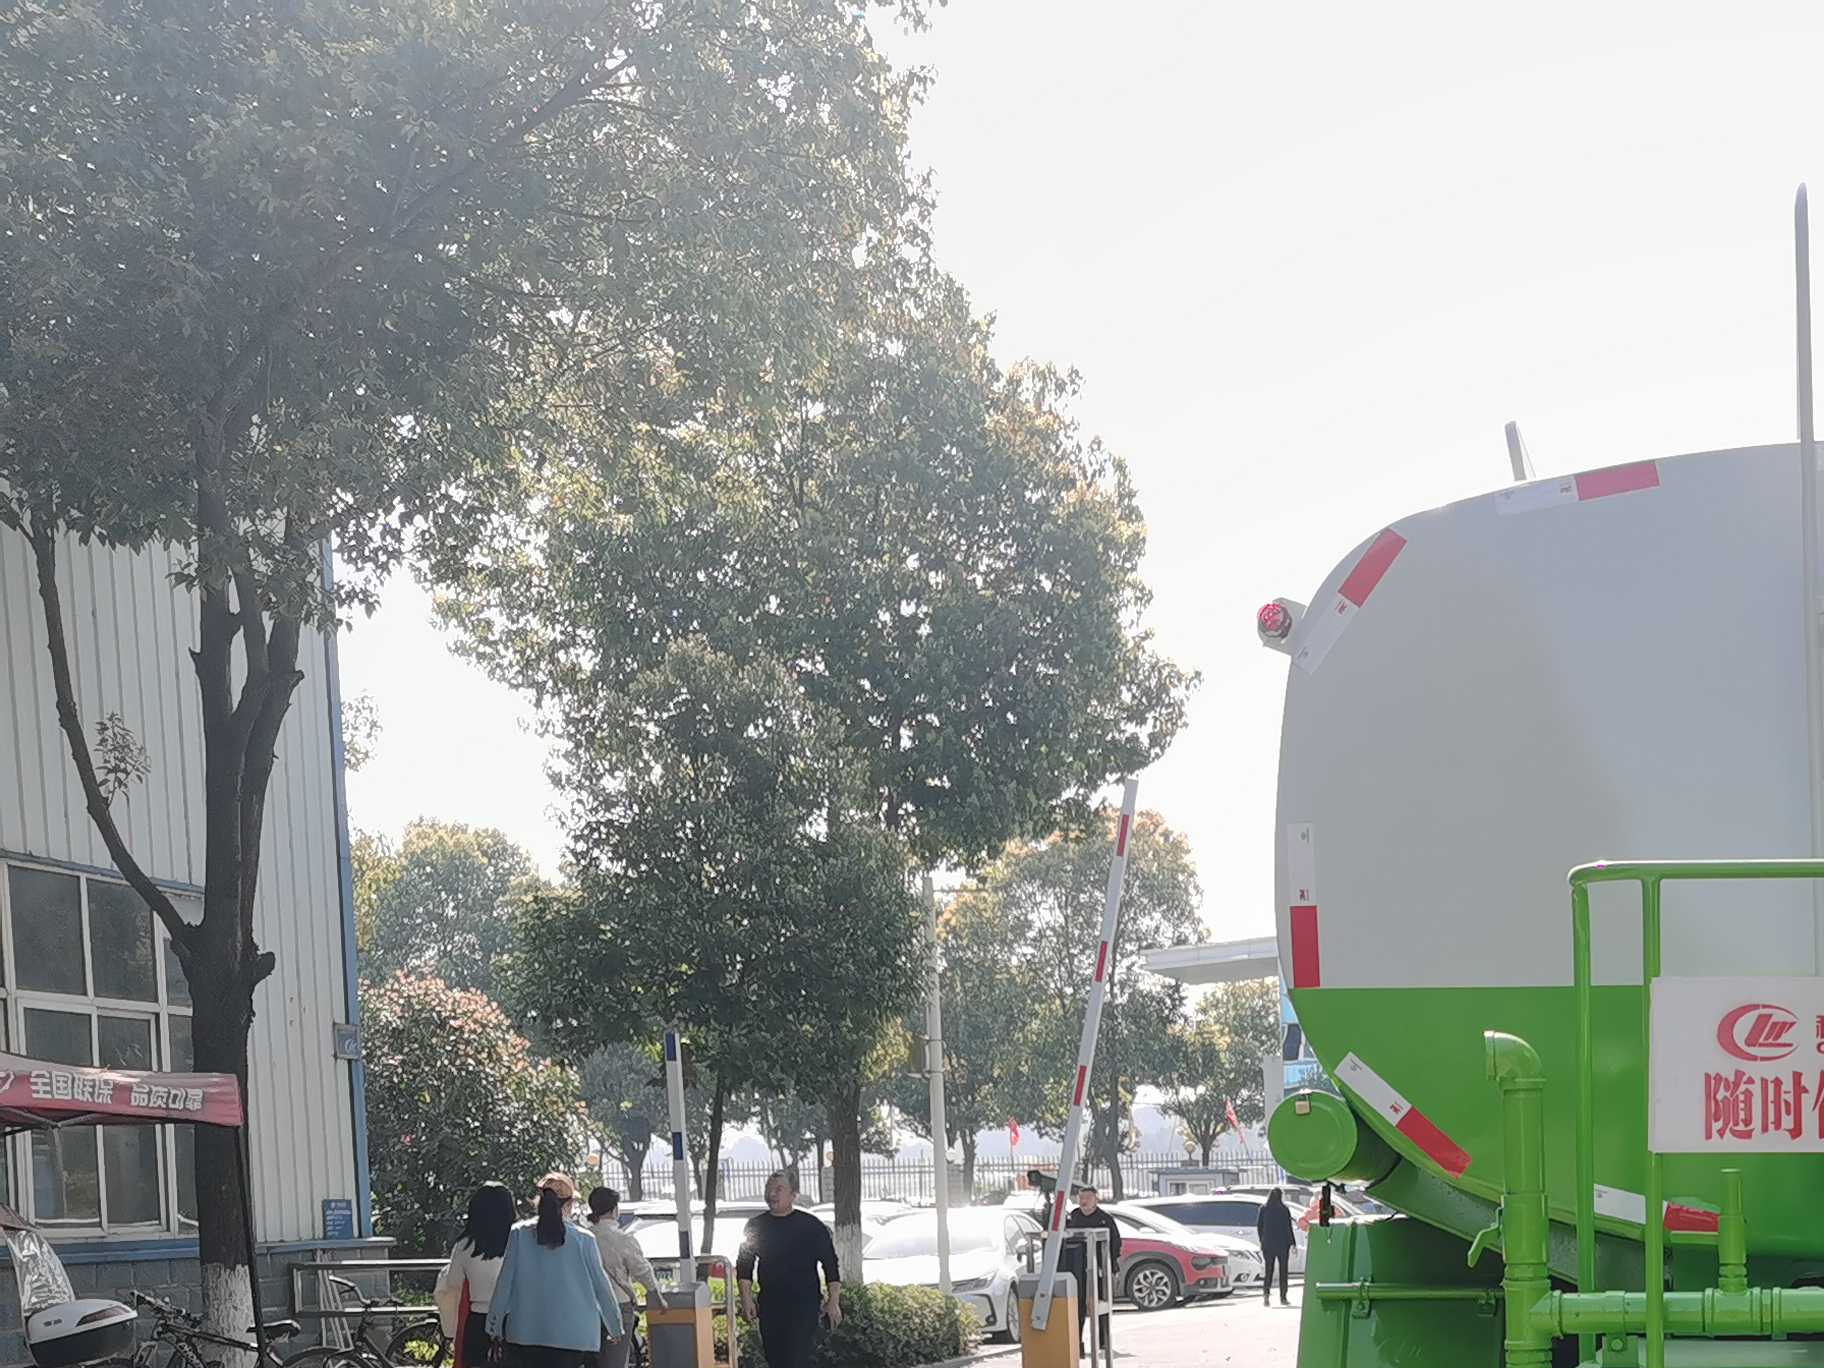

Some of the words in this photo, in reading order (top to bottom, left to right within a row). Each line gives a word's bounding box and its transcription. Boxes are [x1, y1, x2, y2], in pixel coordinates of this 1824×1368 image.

[30, 1070, 113, 1104] 全国联保
[131, 1083, 203, 1110] 品质可靠
